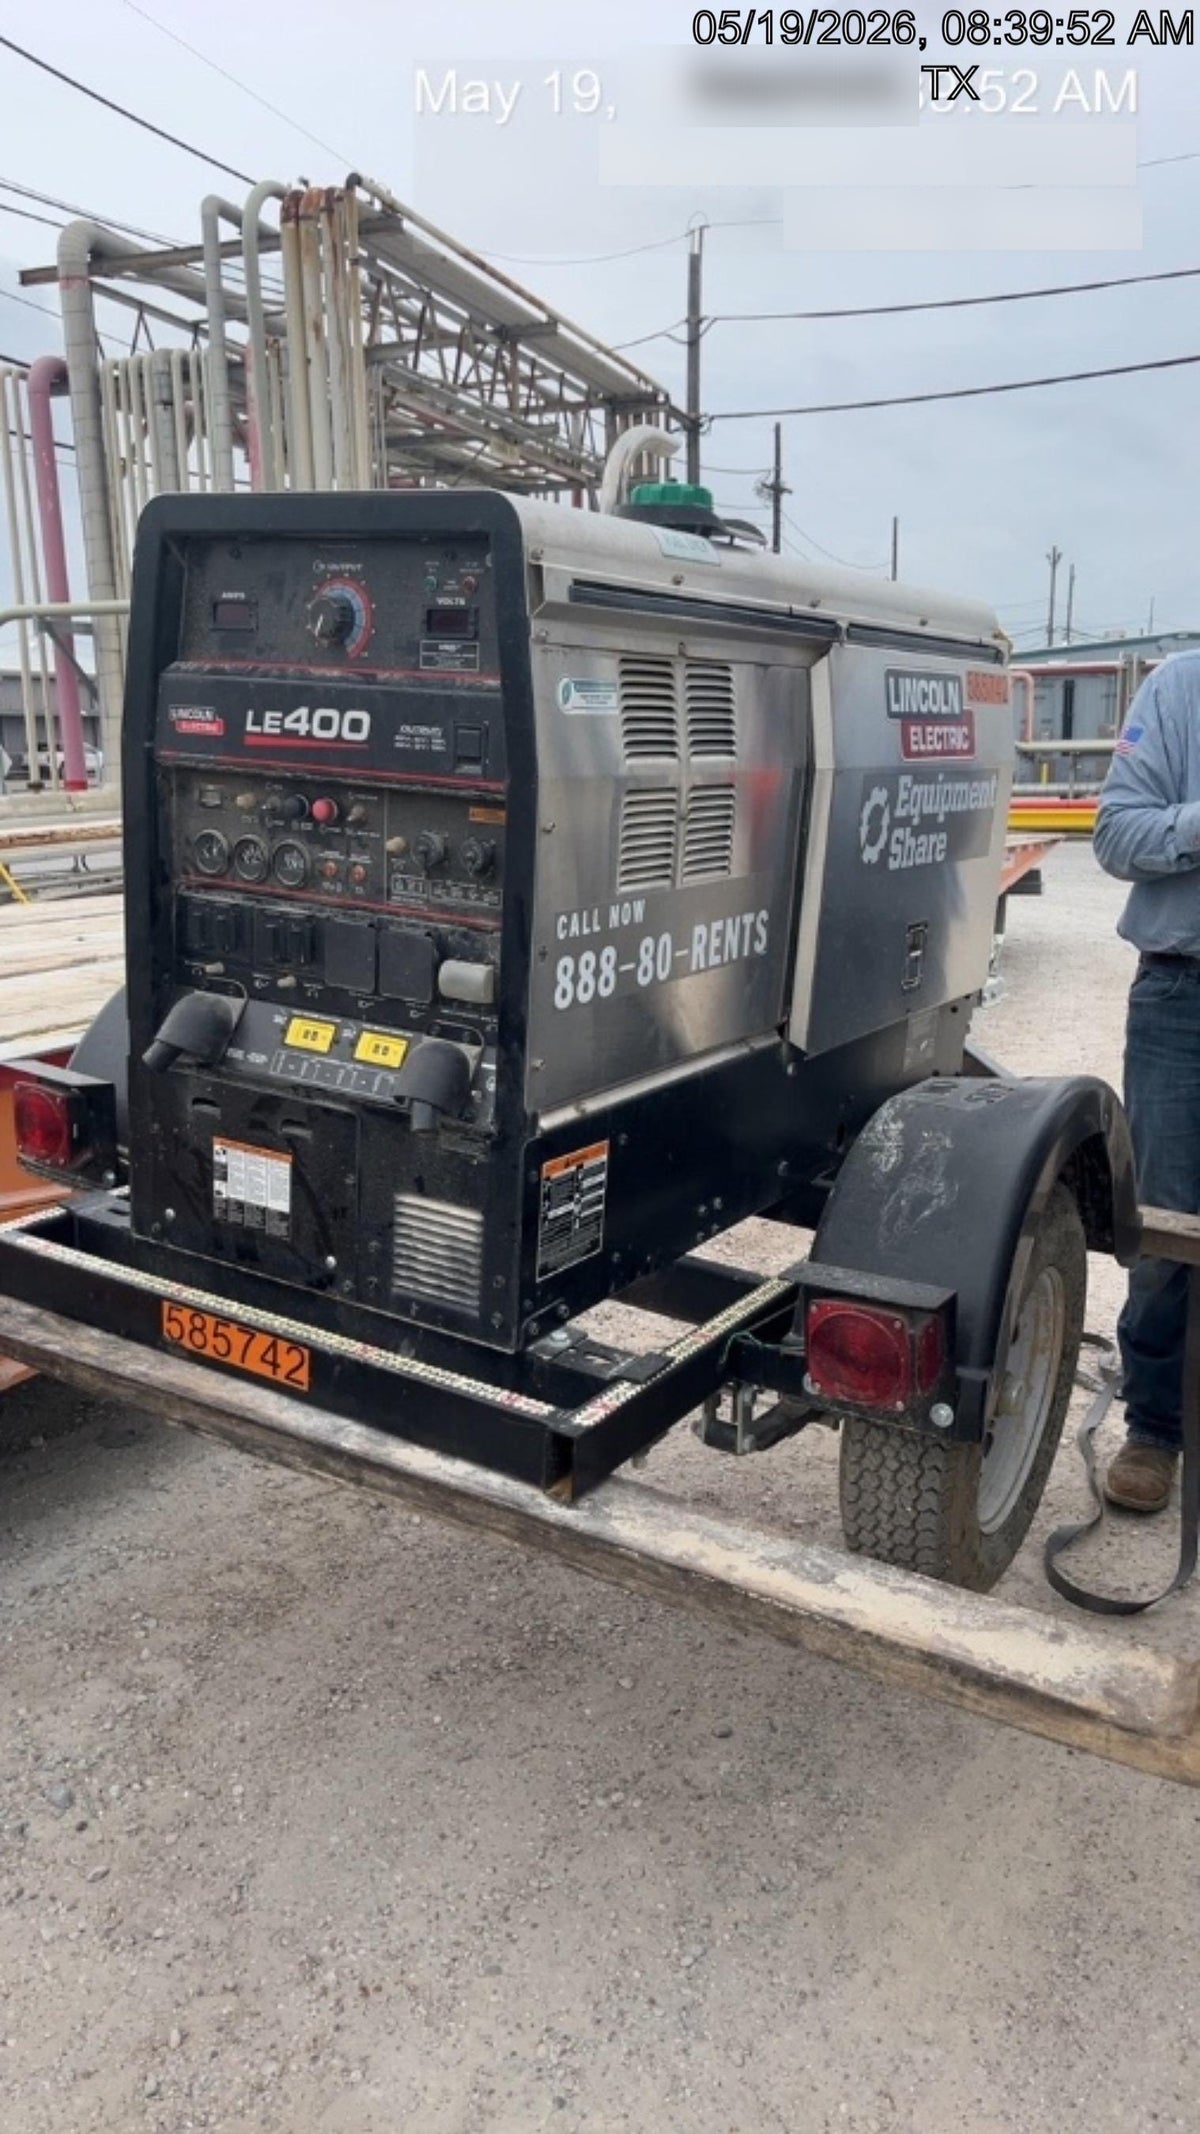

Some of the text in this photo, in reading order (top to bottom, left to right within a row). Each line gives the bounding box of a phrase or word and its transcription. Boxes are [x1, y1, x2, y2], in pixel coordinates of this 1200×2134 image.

[888, 675, 962, 715] LINCOLN
[246, 706, 371, 741] LE400
[909, 725, 970, 752] ELECTRIC
[893, 772, 998, 826] Equipment
[888, 827, 948, 871] Share
[556, 899, 646, 940] CALL NOW
[554, 909, 769, 1010] 888-80-RENTS
[166, 1306, 305, 1386] 585742
